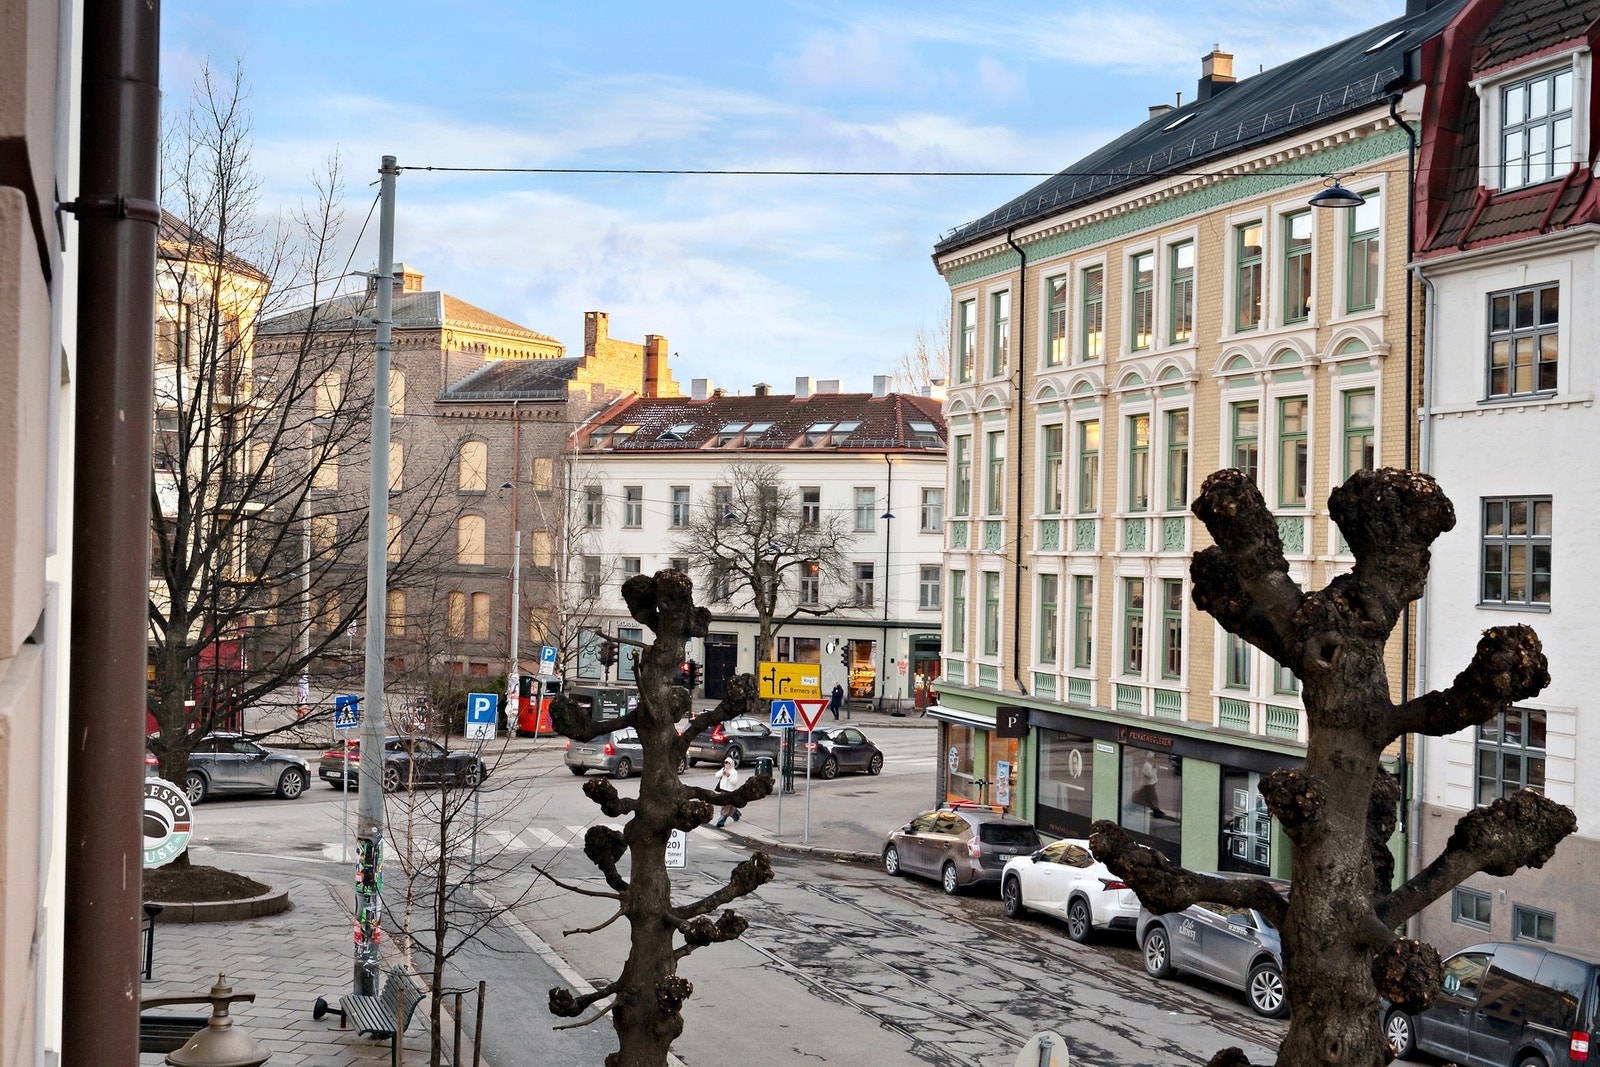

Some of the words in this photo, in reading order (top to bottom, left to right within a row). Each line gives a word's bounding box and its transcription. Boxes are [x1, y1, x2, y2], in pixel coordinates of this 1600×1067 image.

[544, 648, 553, 660] P
[474, 697, 490, 720] P
[1008, 716, 1018, 728] P
